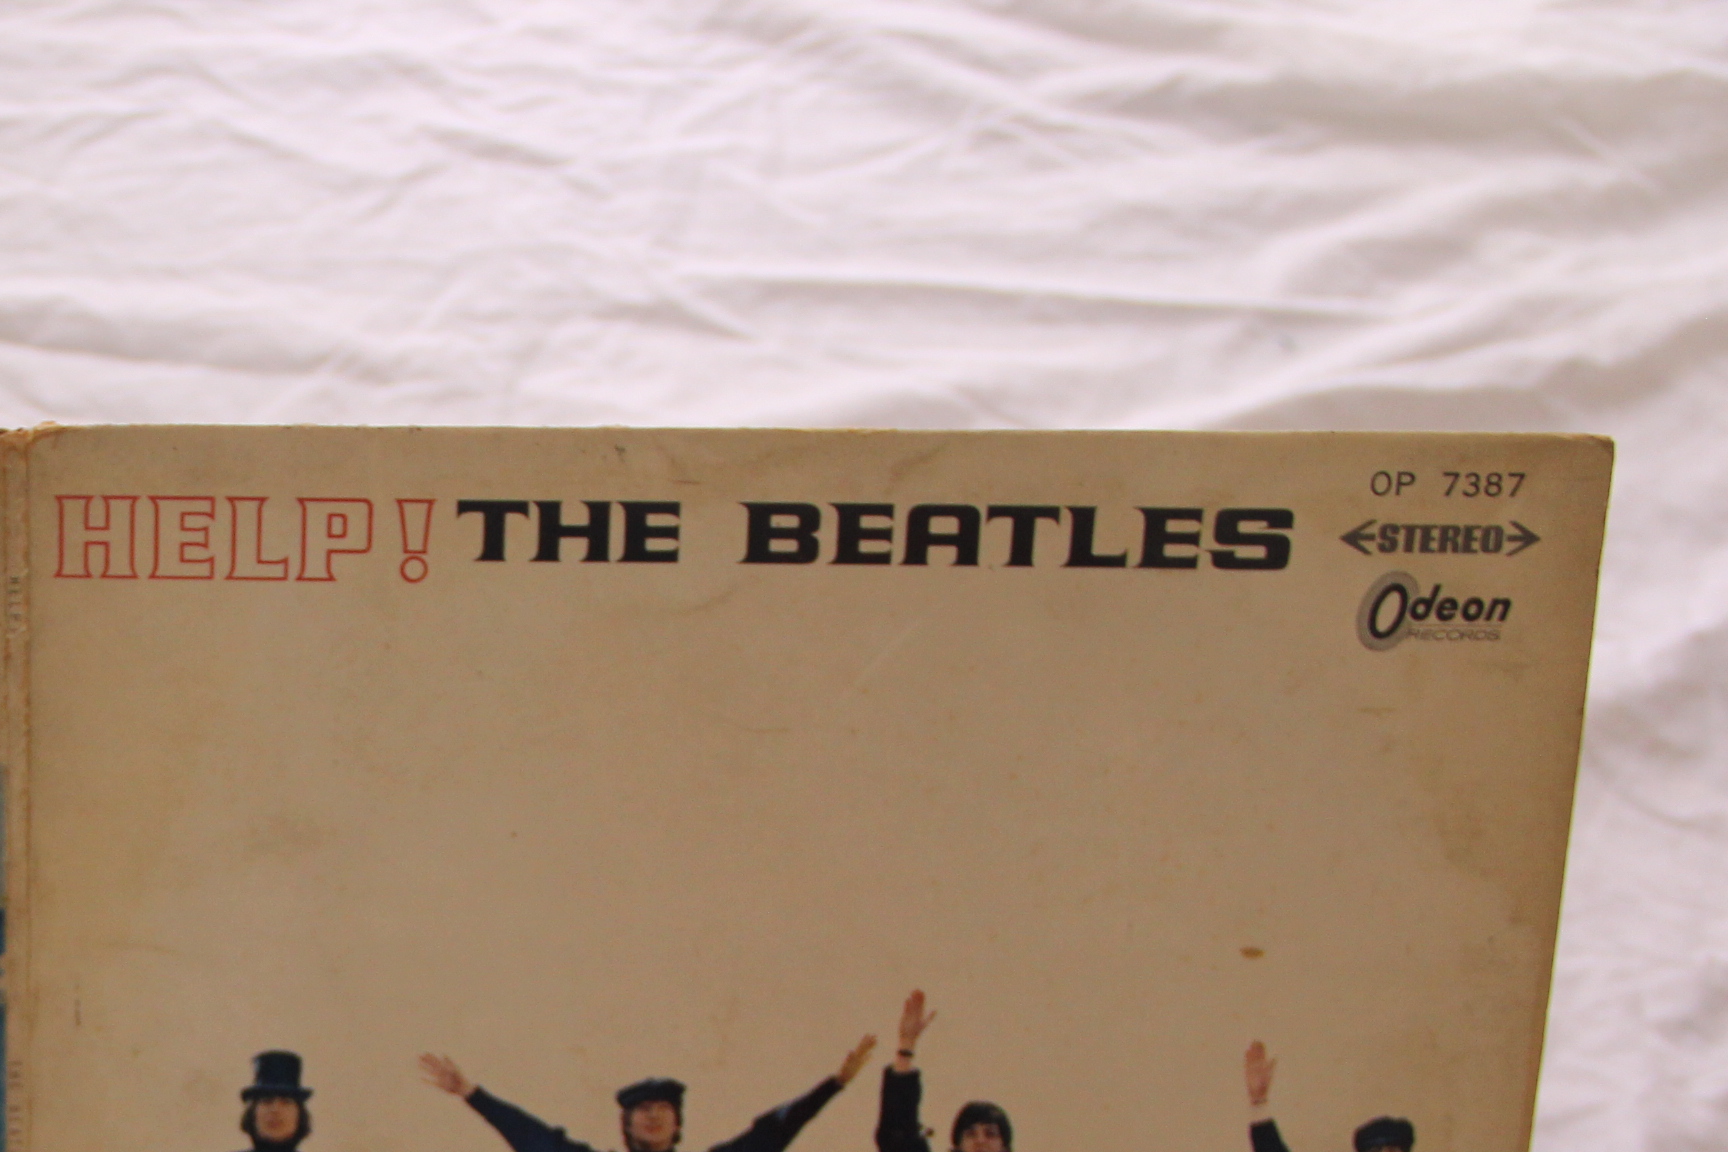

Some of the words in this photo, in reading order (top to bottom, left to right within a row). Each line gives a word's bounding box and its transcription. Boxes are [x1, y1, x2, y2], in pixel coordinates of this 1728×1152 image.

[1370, 470, 1416, 497] OP
[1442, 471, 1527, 498] 7387
[53, 494, 437, 584] HELP!
[457, 499, 681, 563] THE
[740, 502, 1295, 571] BEATLES
[1376, 523, 1504, 554] STEREO
[1366, 582, 1512, 640] Odeon
